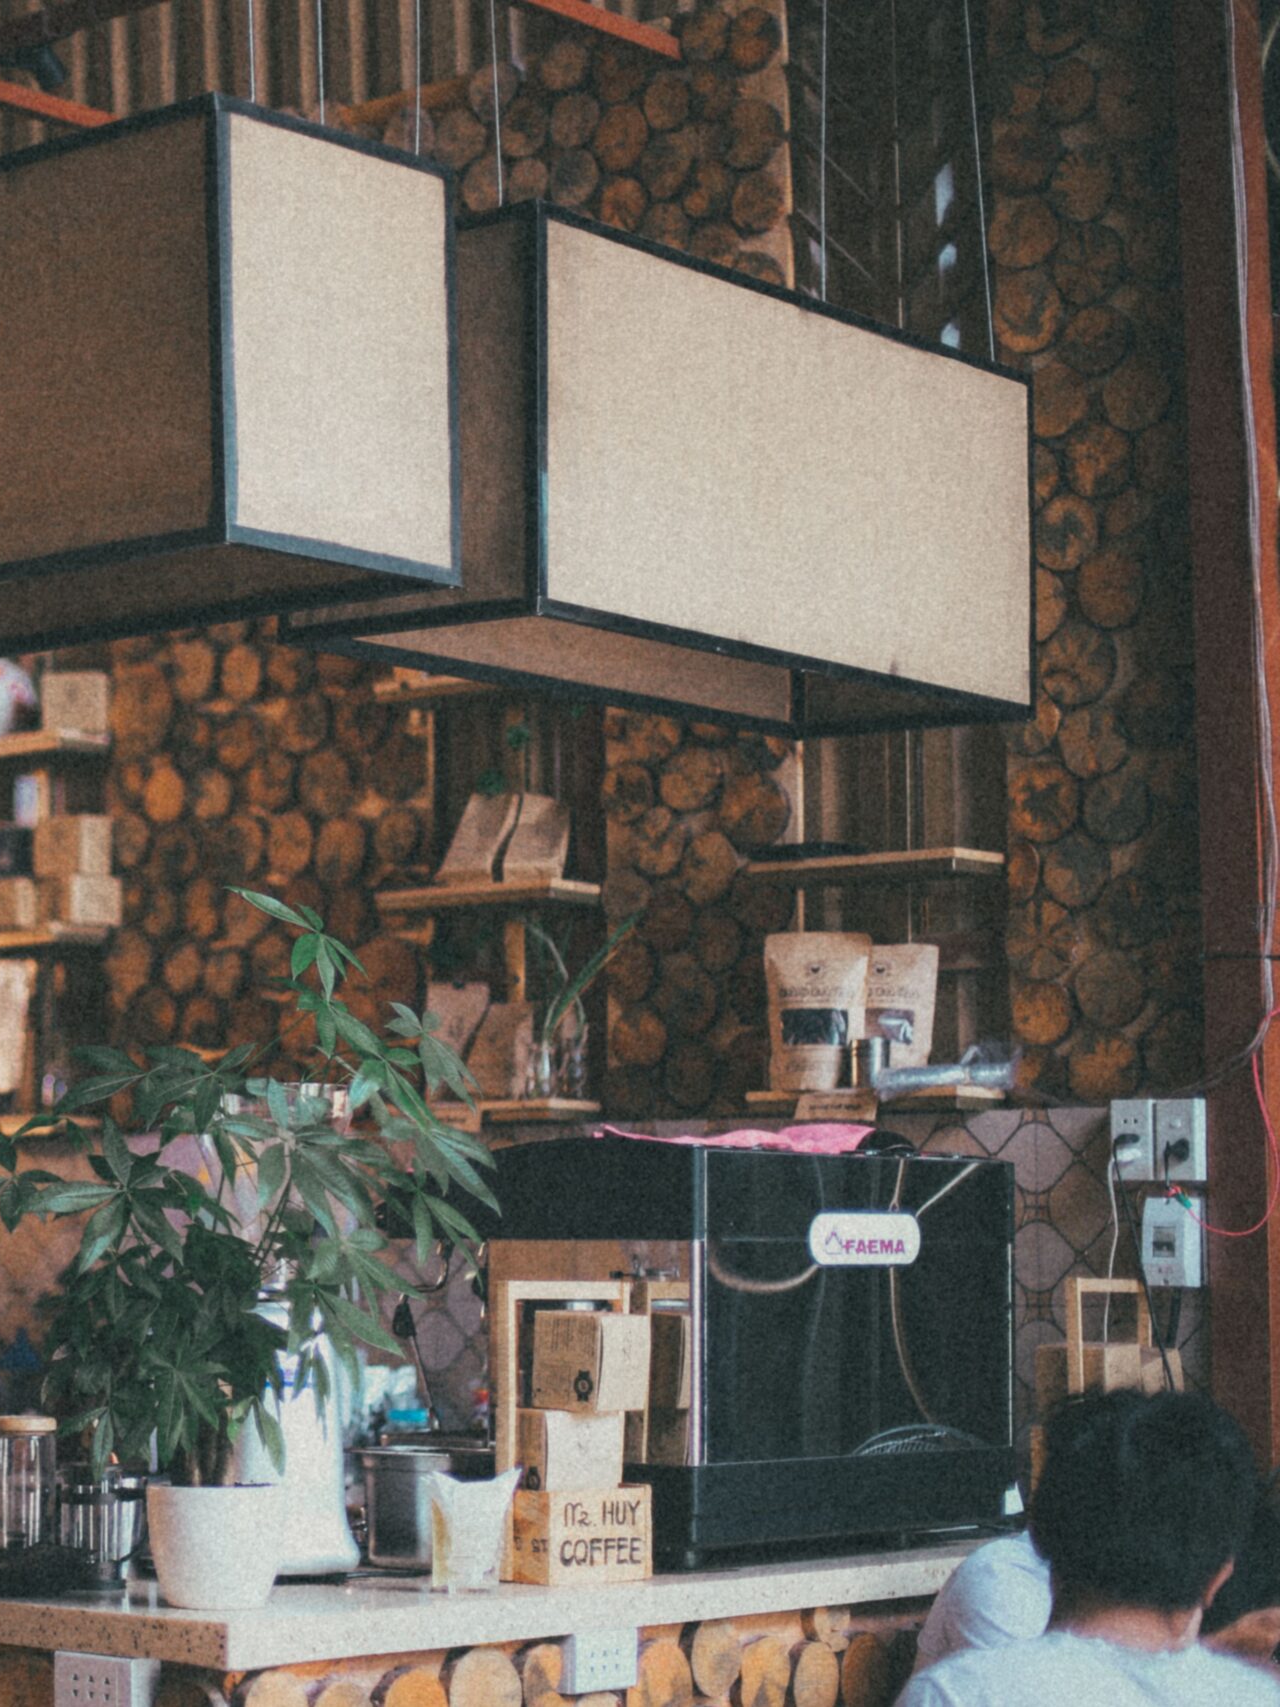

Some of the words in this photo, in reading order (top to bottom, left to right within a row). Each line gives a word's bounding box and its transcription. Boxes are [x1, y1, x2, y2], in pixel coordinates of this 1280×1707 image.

[843, 1239, 905, 1254] FAEMA
[602, 1500, 640, 1525] HUY
[559, 1537, 642, 1567] COFFEE
